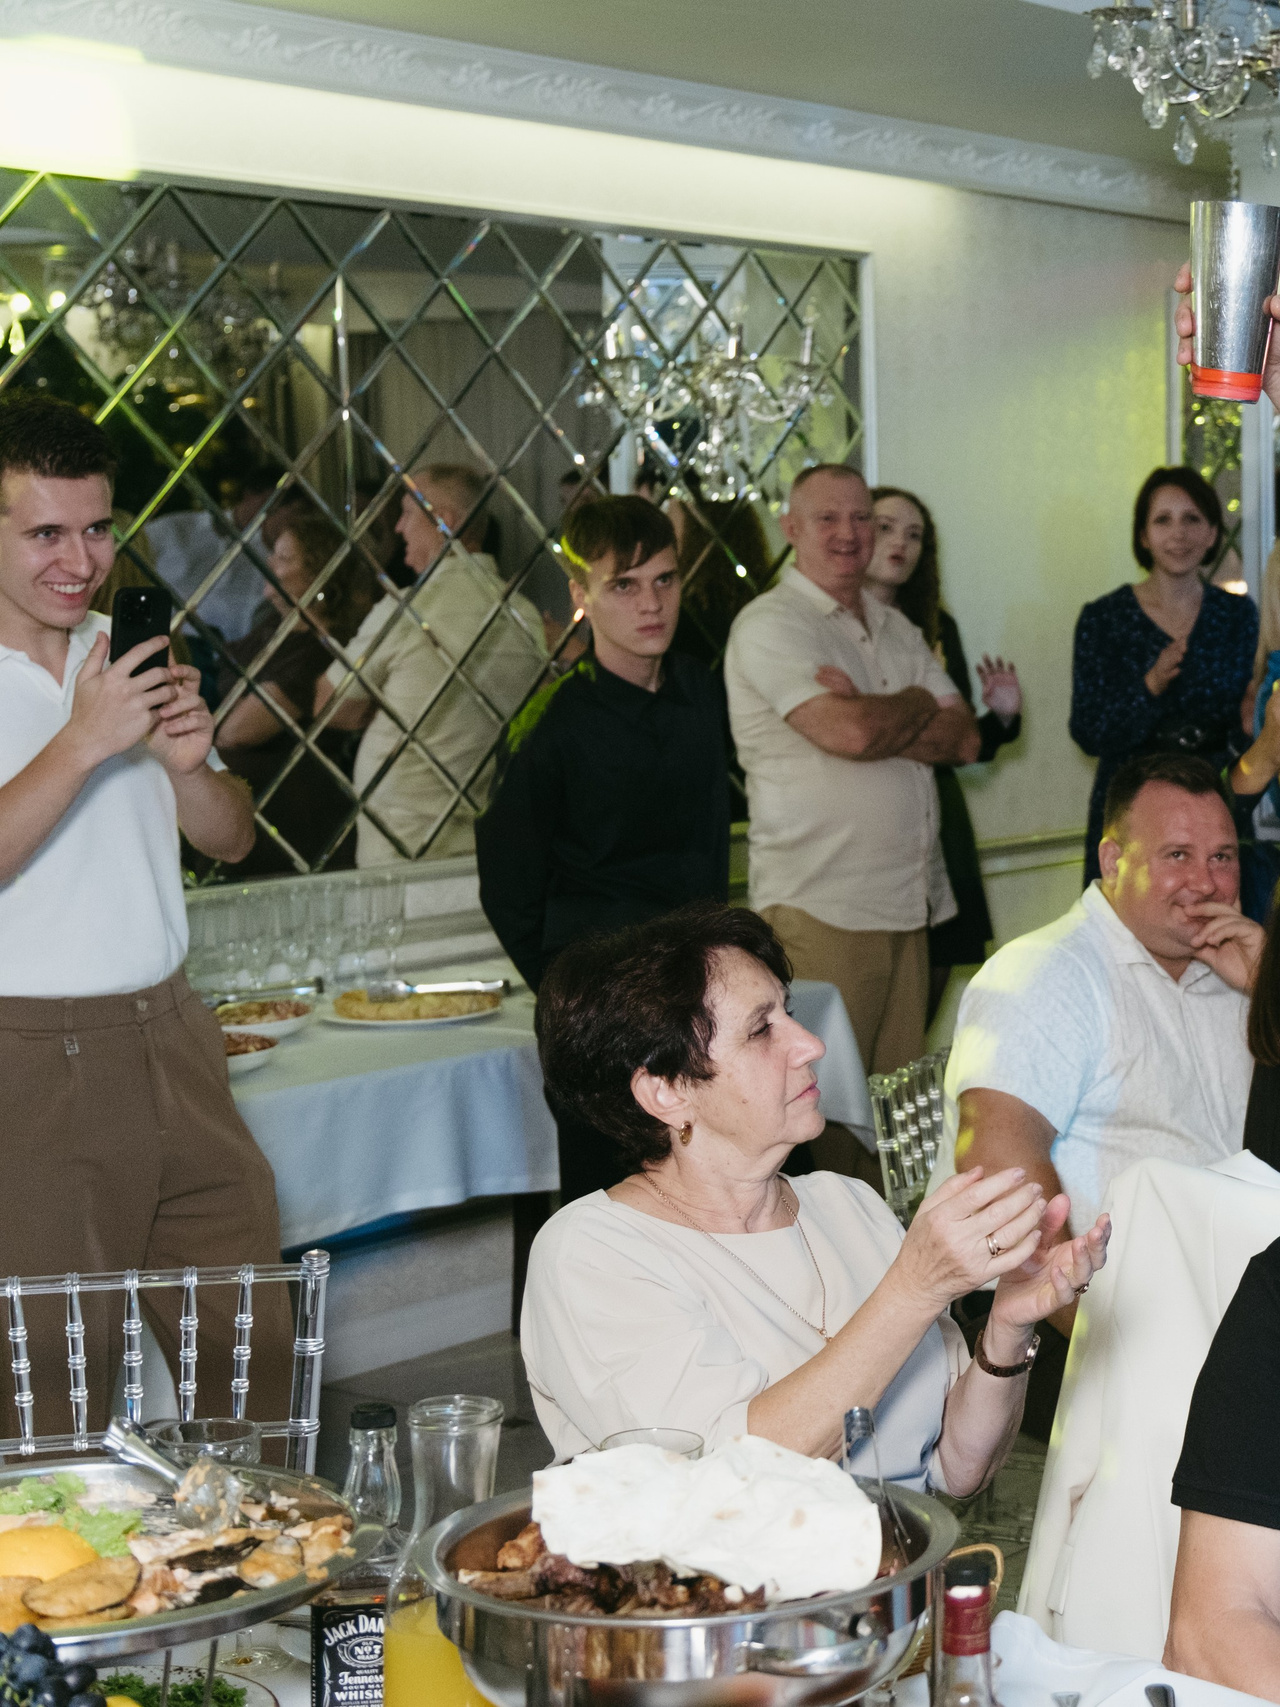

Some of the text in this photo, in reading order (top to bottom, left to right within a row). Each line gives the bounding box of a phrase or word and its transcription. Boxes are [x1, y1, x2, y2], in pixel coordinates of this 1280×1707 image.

[322, 1614, 385, 1646] JACK DAN
[338, 1671, 385, 1685] Tenness
[334, 1689, 384, 1701] WHISK
